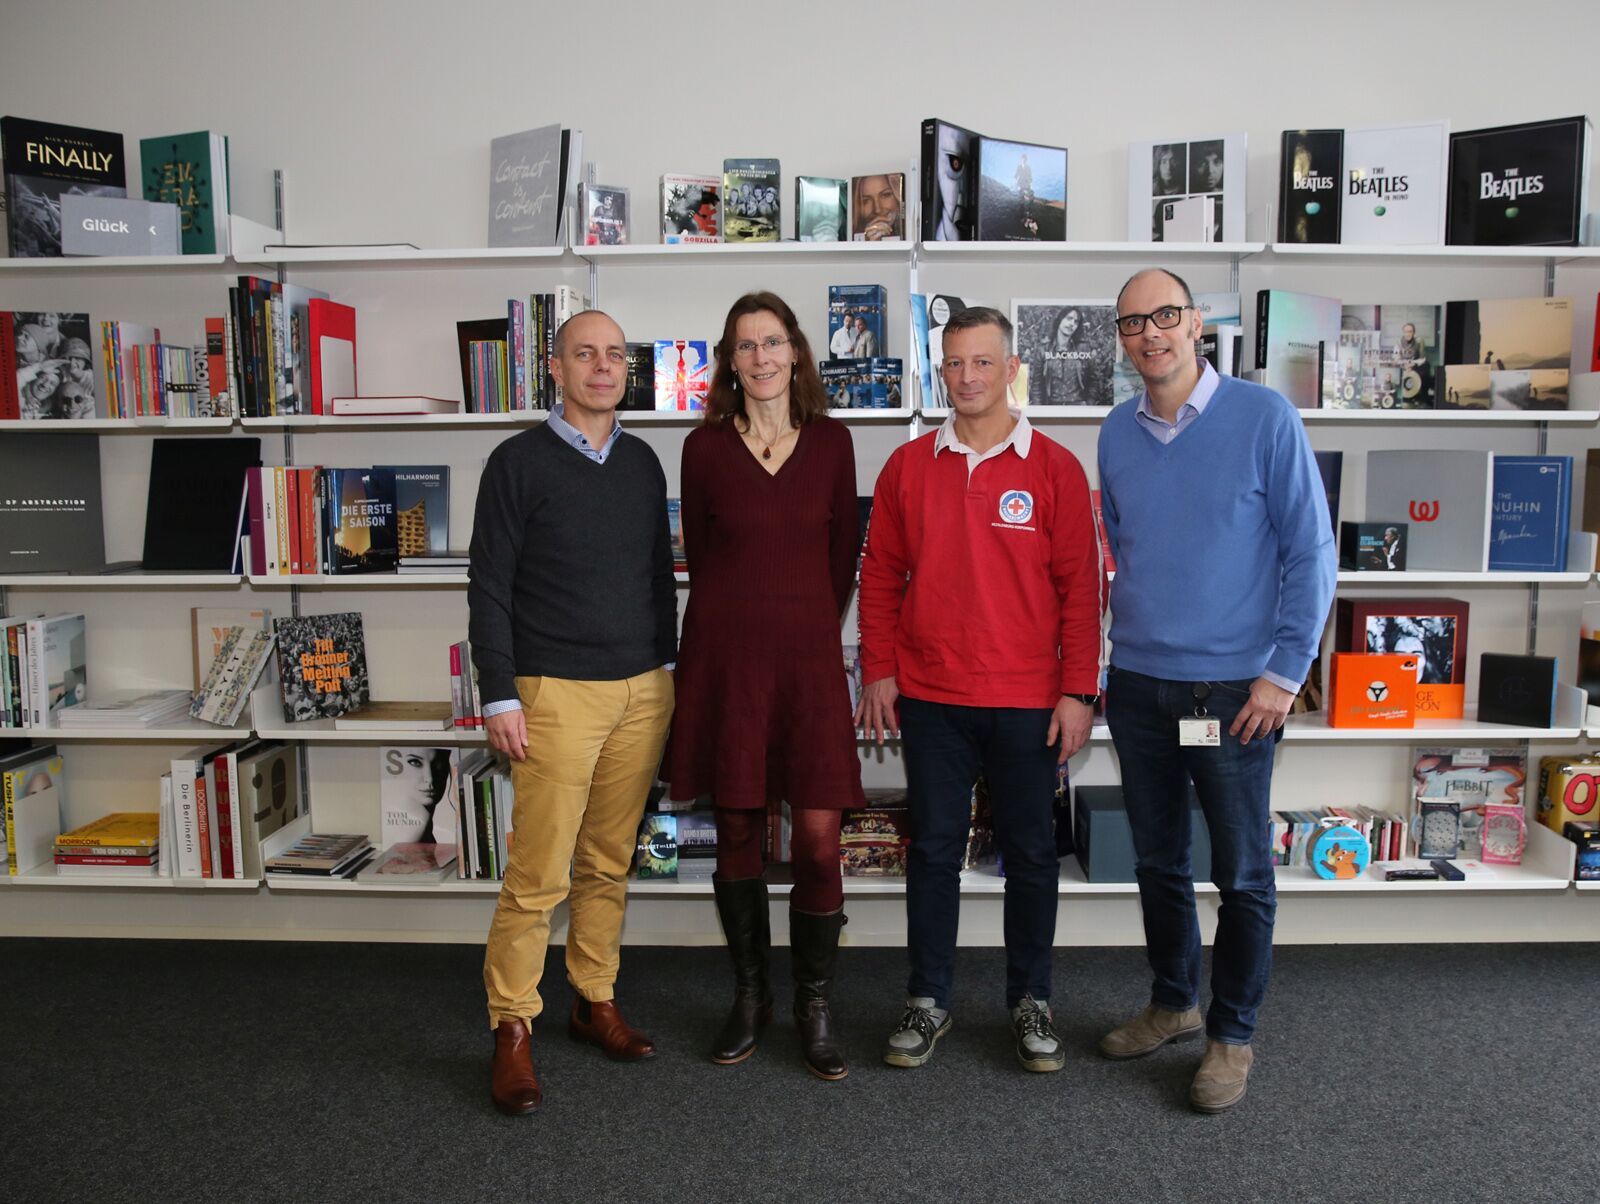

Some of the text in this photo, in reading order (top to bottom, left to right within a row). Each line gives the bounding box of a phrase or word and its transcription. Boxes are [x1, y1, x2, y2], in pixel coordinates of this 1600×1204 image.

[26, 141, 114, 173] FINALLY
[495, 151, 551, 184] Contact
[1372, 167, 1384, 175] THE
[1505, 168, 1519, 177] THE
[1293, 172, 1334, 192] BEATLES
[1349, 170, 1408, 198] BEATLES
[1480, 171, 1544, 201] BEATLES
[495, 185, 553, 221] Content
[82, 218, 130, 235] Glück
[1045, 351, 1092, 360] BLACKBOX
[395, 473, 440, 481] HILHARMONIE
[341, 503, 392, 517] DIE ERSTE
[350, 516, 386, 528] SAISON
[301, 650, 349, 667] Brönner
[303, 664, 351, 682] Melting
[1416, 690, 1434, 702] GE
[385, 749, 404, 775] S
[5, 774, 13, 805] TUSH
[181, 784, 193, 853] Die Berlinerin
[386, 811, 408, 819] TOM
[386, 818, 422, 826] MUNRO
[860, 819, 876, 830] 60
[59, 838, 101, 846] MORRICONE
[487, 818, 495, 851] AMAROK
